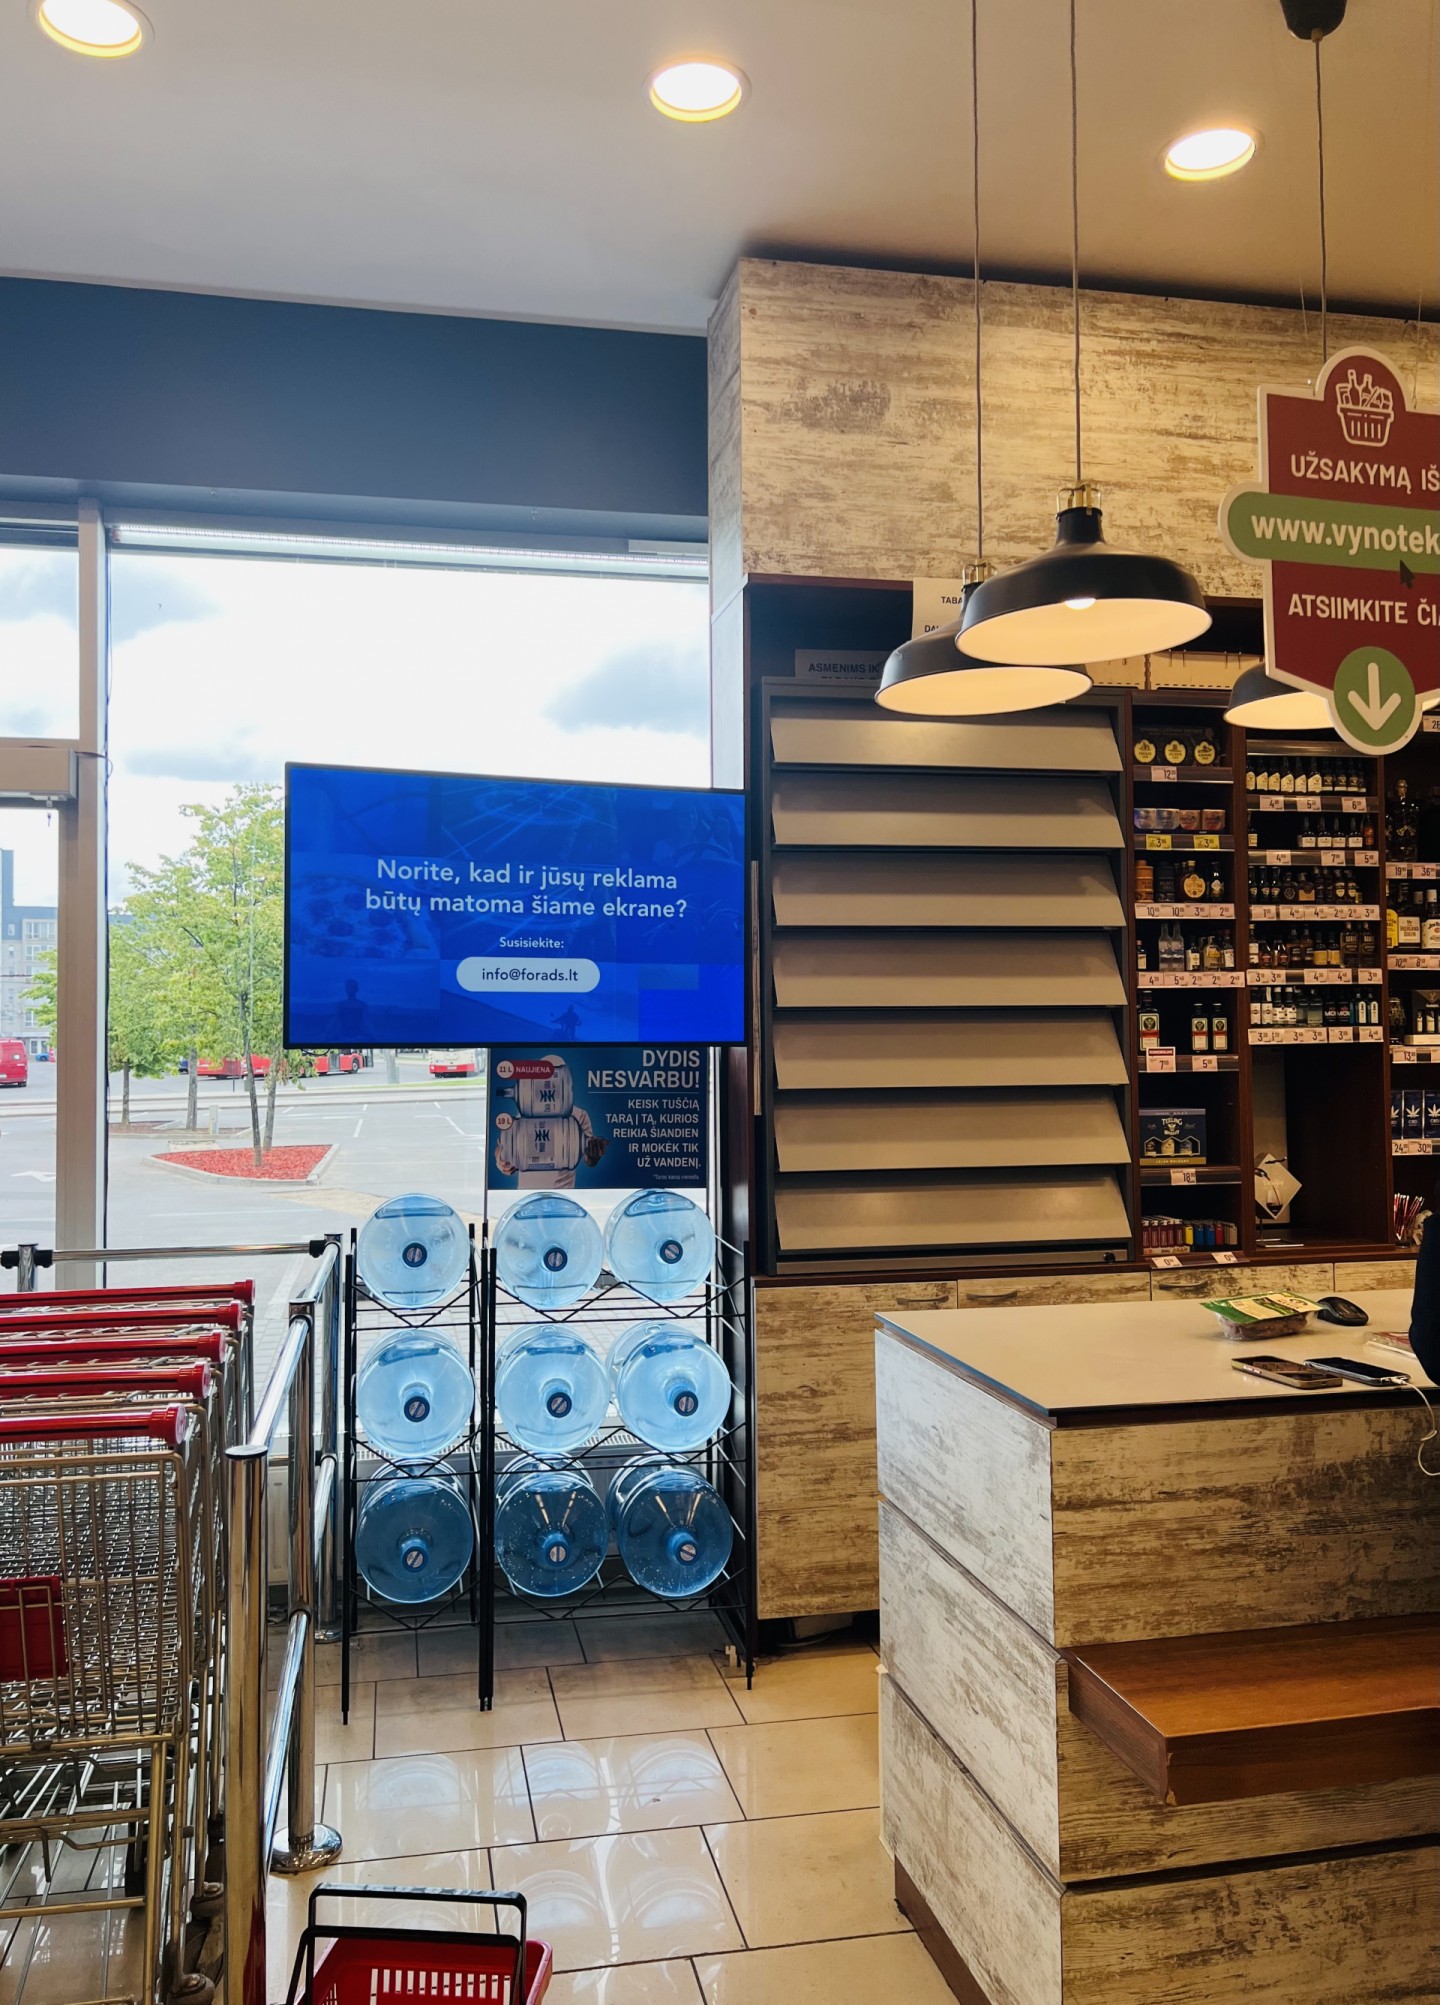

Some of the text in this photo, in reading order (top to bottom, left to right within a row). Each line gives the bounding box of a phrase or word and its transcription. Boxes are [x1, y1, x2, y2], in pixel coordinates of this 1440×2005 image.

[1290, 450, 1412, 495] UŽSAKYMĄ
[1251, 515, 1440, 556] www.vynotek
[1288, 593, 1408, 624] ATSIIMKITE
[808, 662, 865, 674] ASMENIMS
[377, 858, 677, 892] Norite, kad ir jūsų reklama
[365, 889, 687, 919] būtų matoma šiame ekrane?
[499, 936, 565, 949] Susisiekite:
[481, 966, 579, 983] info@forads.lt
[642, 1050, 700, 1067] DYDIS
[587, 1070, 700, 1088] NESVARBU!
[628, 1098, 700, 1111] KEISK TUŠČIĄ
[605, 1113, 634, 1126] TARĄ
[642, 1113, 657, 1125] TĄ,
[659, 1113, 699, 1123] KURIOS
[613, 1126, 699, 1138] REIKIA ŠIANDIEN
[628, 1141, 699, 1152] IR MOKĖK TIK
[637, 1155, 701, 1169] UŽ VANDENĮ.
